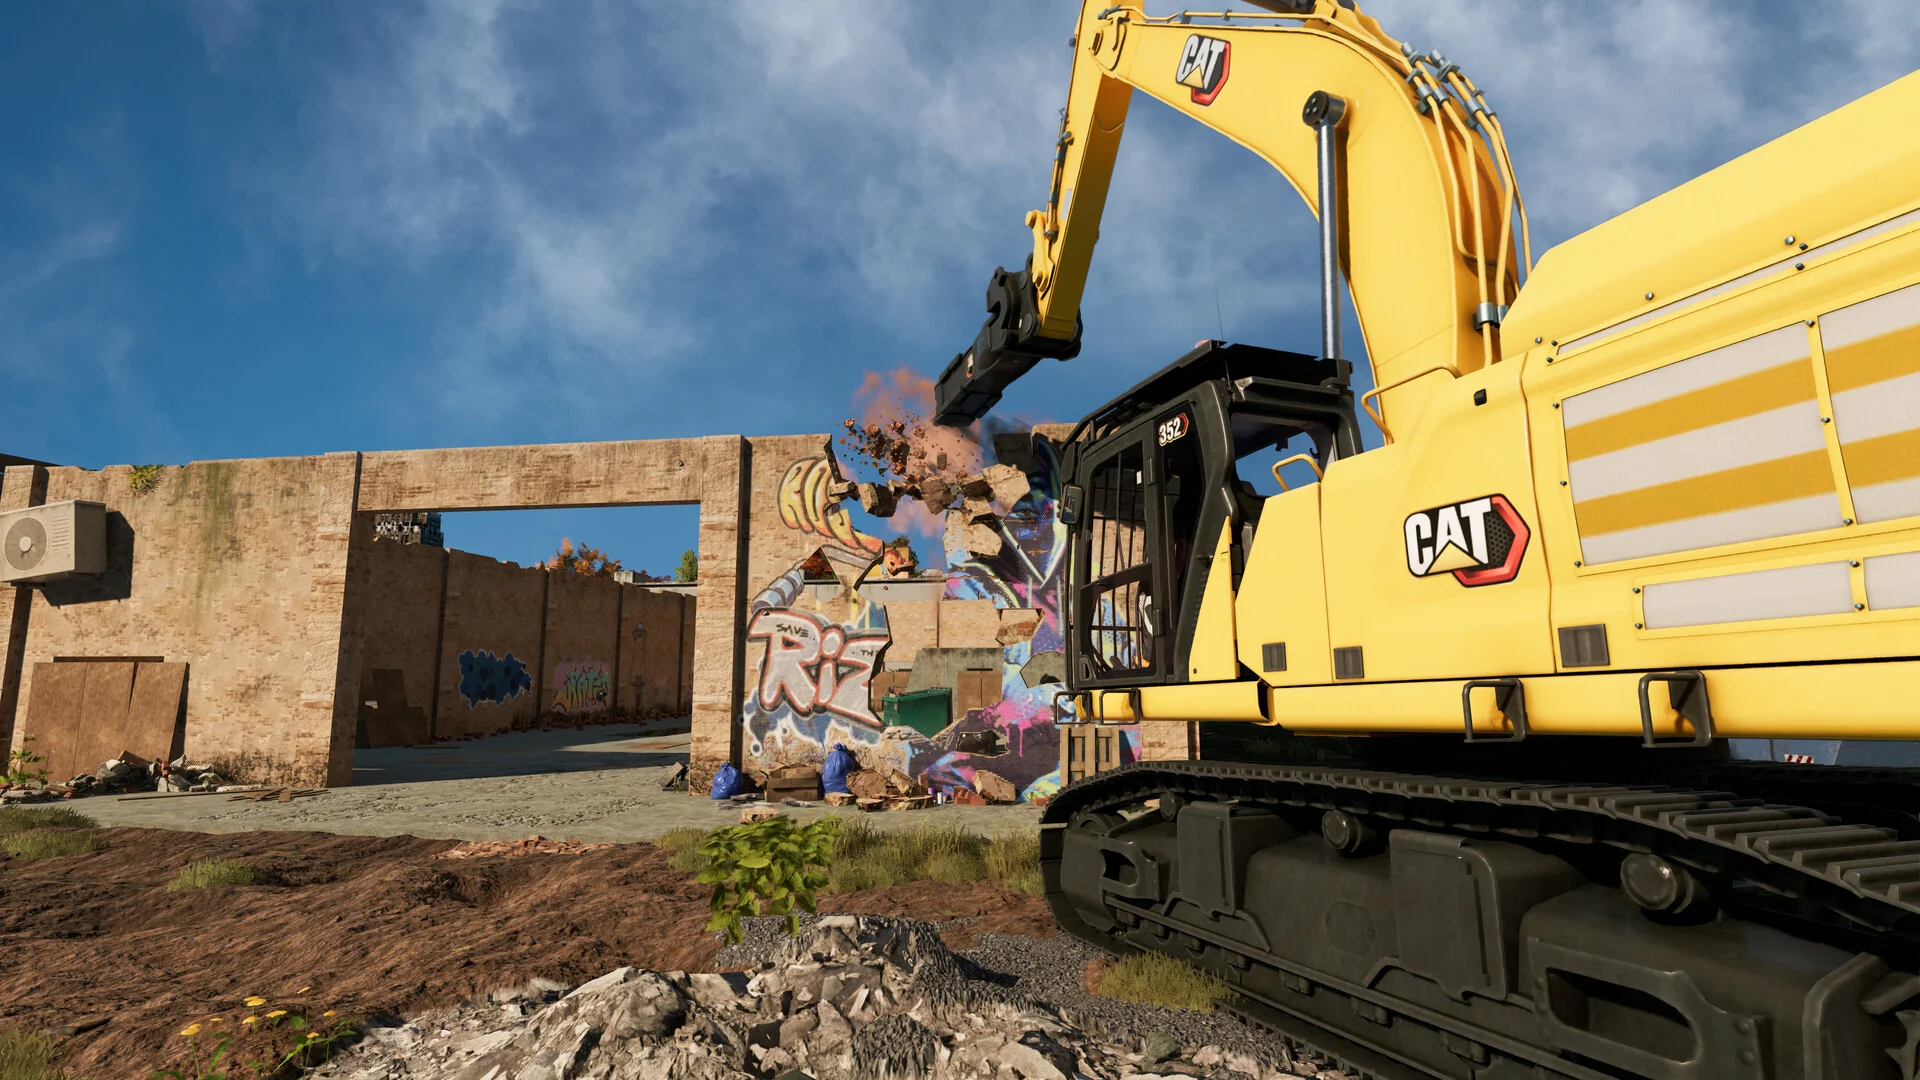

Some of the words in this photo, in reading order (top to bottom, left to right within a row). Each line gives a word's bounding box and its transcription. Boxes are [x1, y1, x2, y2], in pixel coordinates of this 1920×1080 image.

[1176, 35, 1226, 89] CAT
[1160, 417, 1181, 443] 352
[1404, 498, 1492, 576] CAT
